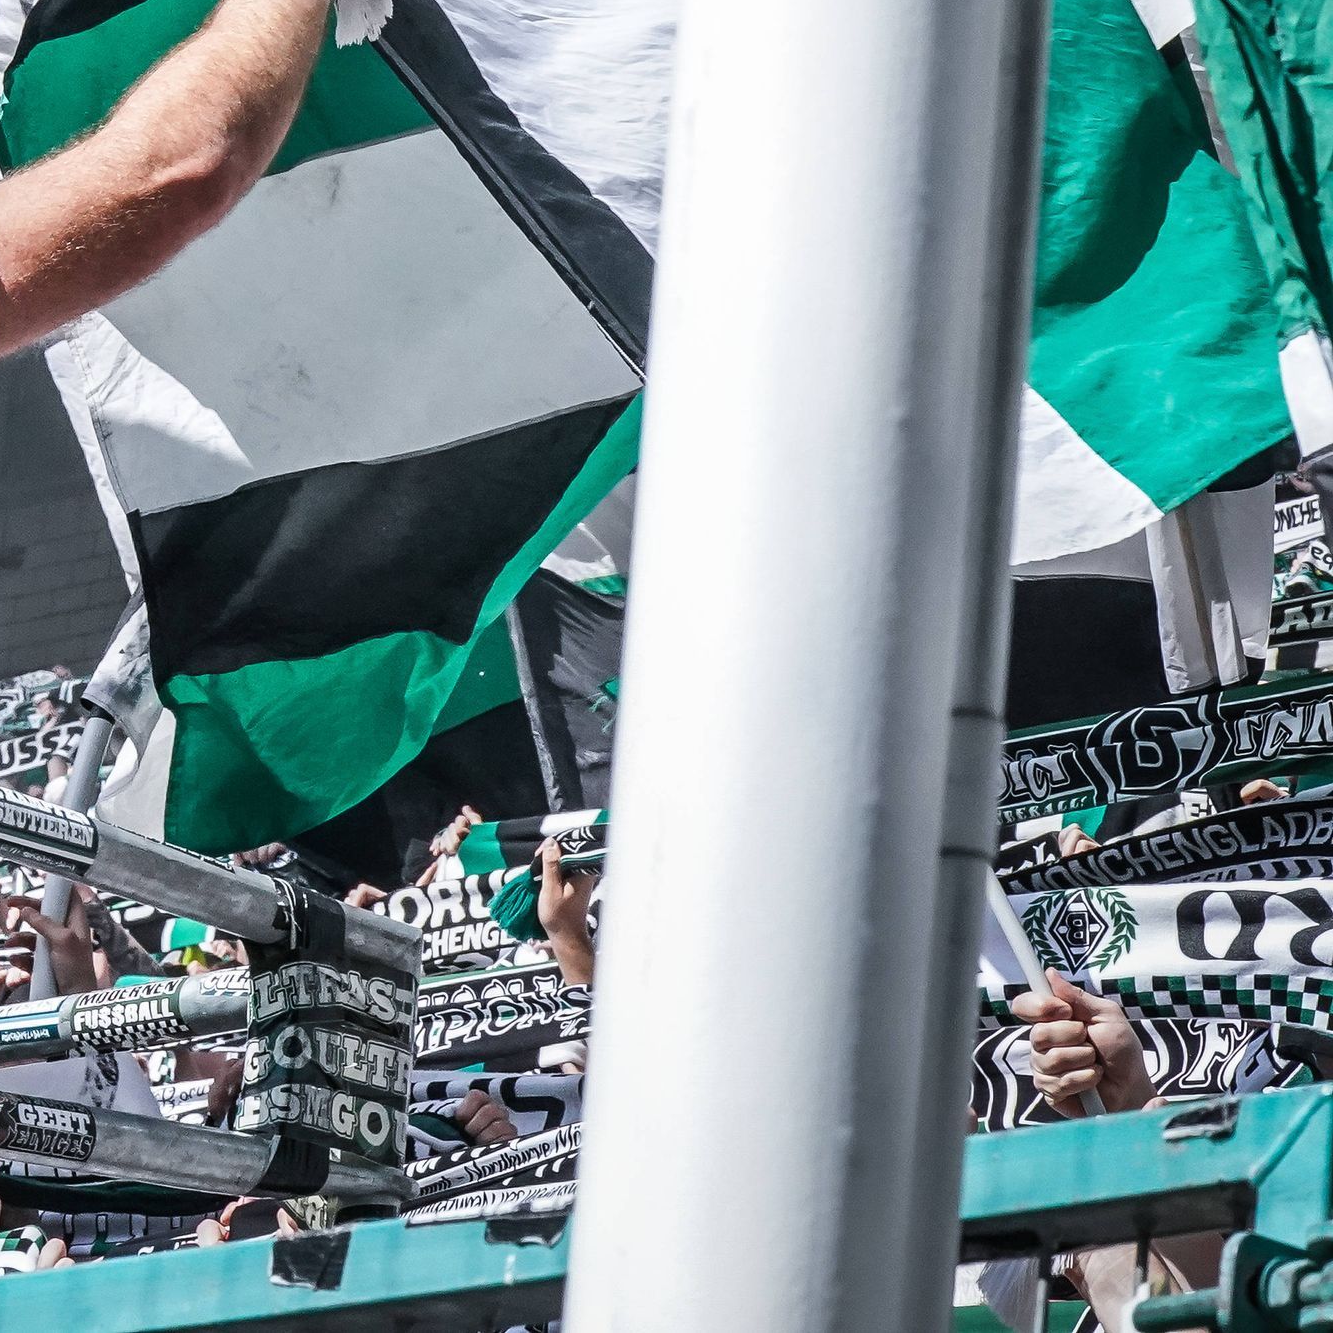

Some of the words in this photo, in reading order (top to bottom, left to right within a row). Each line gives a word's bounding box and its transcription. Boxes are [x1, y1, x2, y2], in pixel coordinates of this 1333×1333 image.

[77, 976, 183, 1012] MODERNEN
[17, 1102, 92, 1135] GEHT
[9, 1122, 93, 1162] EINIGES
